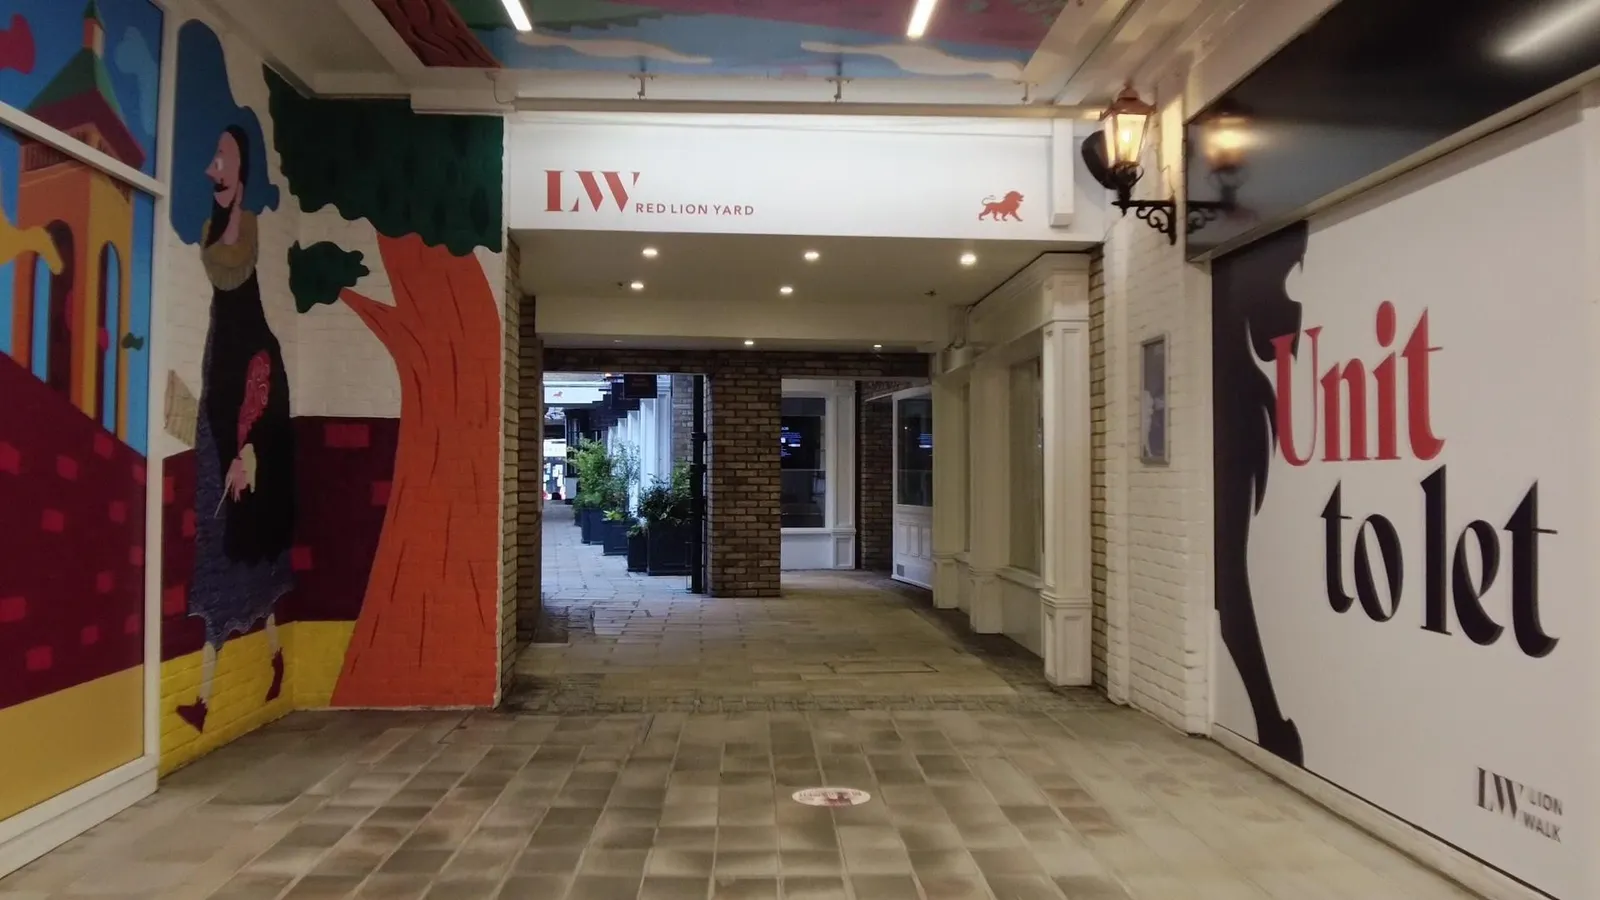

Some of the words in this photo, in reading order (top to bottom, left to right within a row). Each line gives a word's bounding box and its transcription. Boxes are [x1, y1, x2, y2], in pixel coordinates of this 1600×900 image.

[544, 170, 641, 213] LW
[636, 203, 666, 214] RED
[671, 203, 708, 215] LION
[713, 204, 754, 216] YARD
[1270, 300, 1446, 466] Unit
[1320, 480, 1403, 622] to
[1420, 464, 1560, 658] let
[1477, 766, 1524, 819] LW
[1528, 787, 1562, 816] LION
[1523, 811, 1561, 844] WALK
